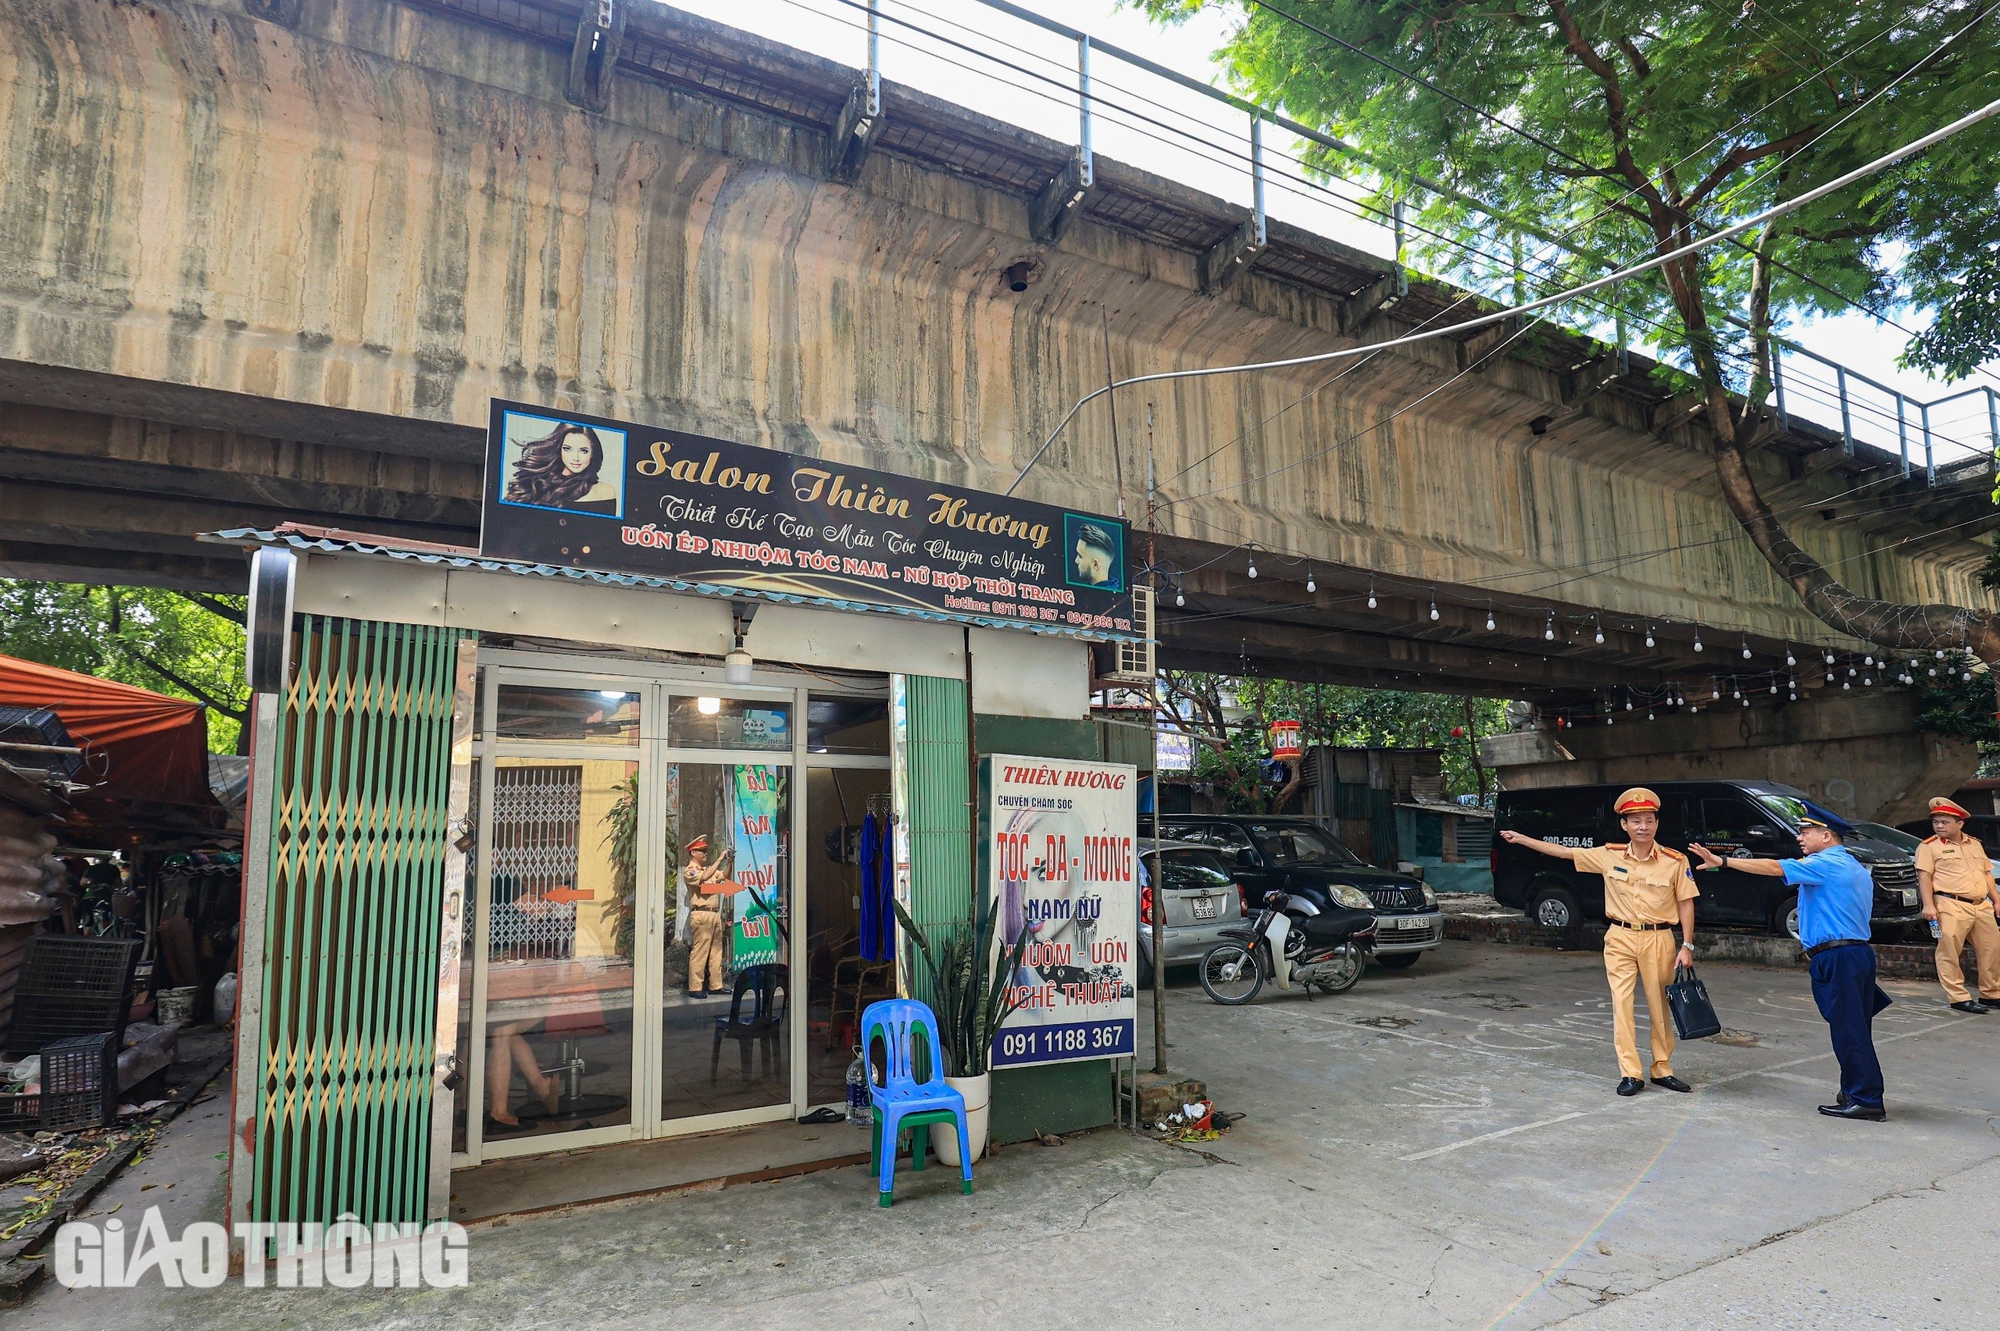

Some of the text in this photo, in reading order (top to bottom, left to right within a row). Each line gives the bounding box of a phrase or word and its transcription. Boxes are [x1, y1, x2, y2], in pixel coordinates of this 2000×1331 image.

[636, 441, 1051, 549] Salon Thiên Hương
[659, 494, 1046, 580] Thiết Kế Tạo Mẫu Tóc Chuyên Nghiệp
[621, 523, 1076, 606] UỐN ÉP NHUỘM TÓC NAM - NỮ HỢP THỜI TRANG
[944, 594, 990, 613] Hotline:
[992, 601, 1016, 616] 0911
[1018, 604, 1038, 619] 188
[1039, 607, 1059, 621] 367
[1003, 764, 1126, 790] THIÊN HƯƠNG
[997, 824, 1029, 881] TÓC
[1046, 834, 1068, 881] DA
[1083, 827, 1131, 882] MÓNG
[1028, 894, 1101, 920] NAM NỮ
[1091, 935, 1128, 964] UỐN
[1062, 978, 1123, 1008] THUẬT
[1003, 1025, 1123, 1056] 091 1188 367
